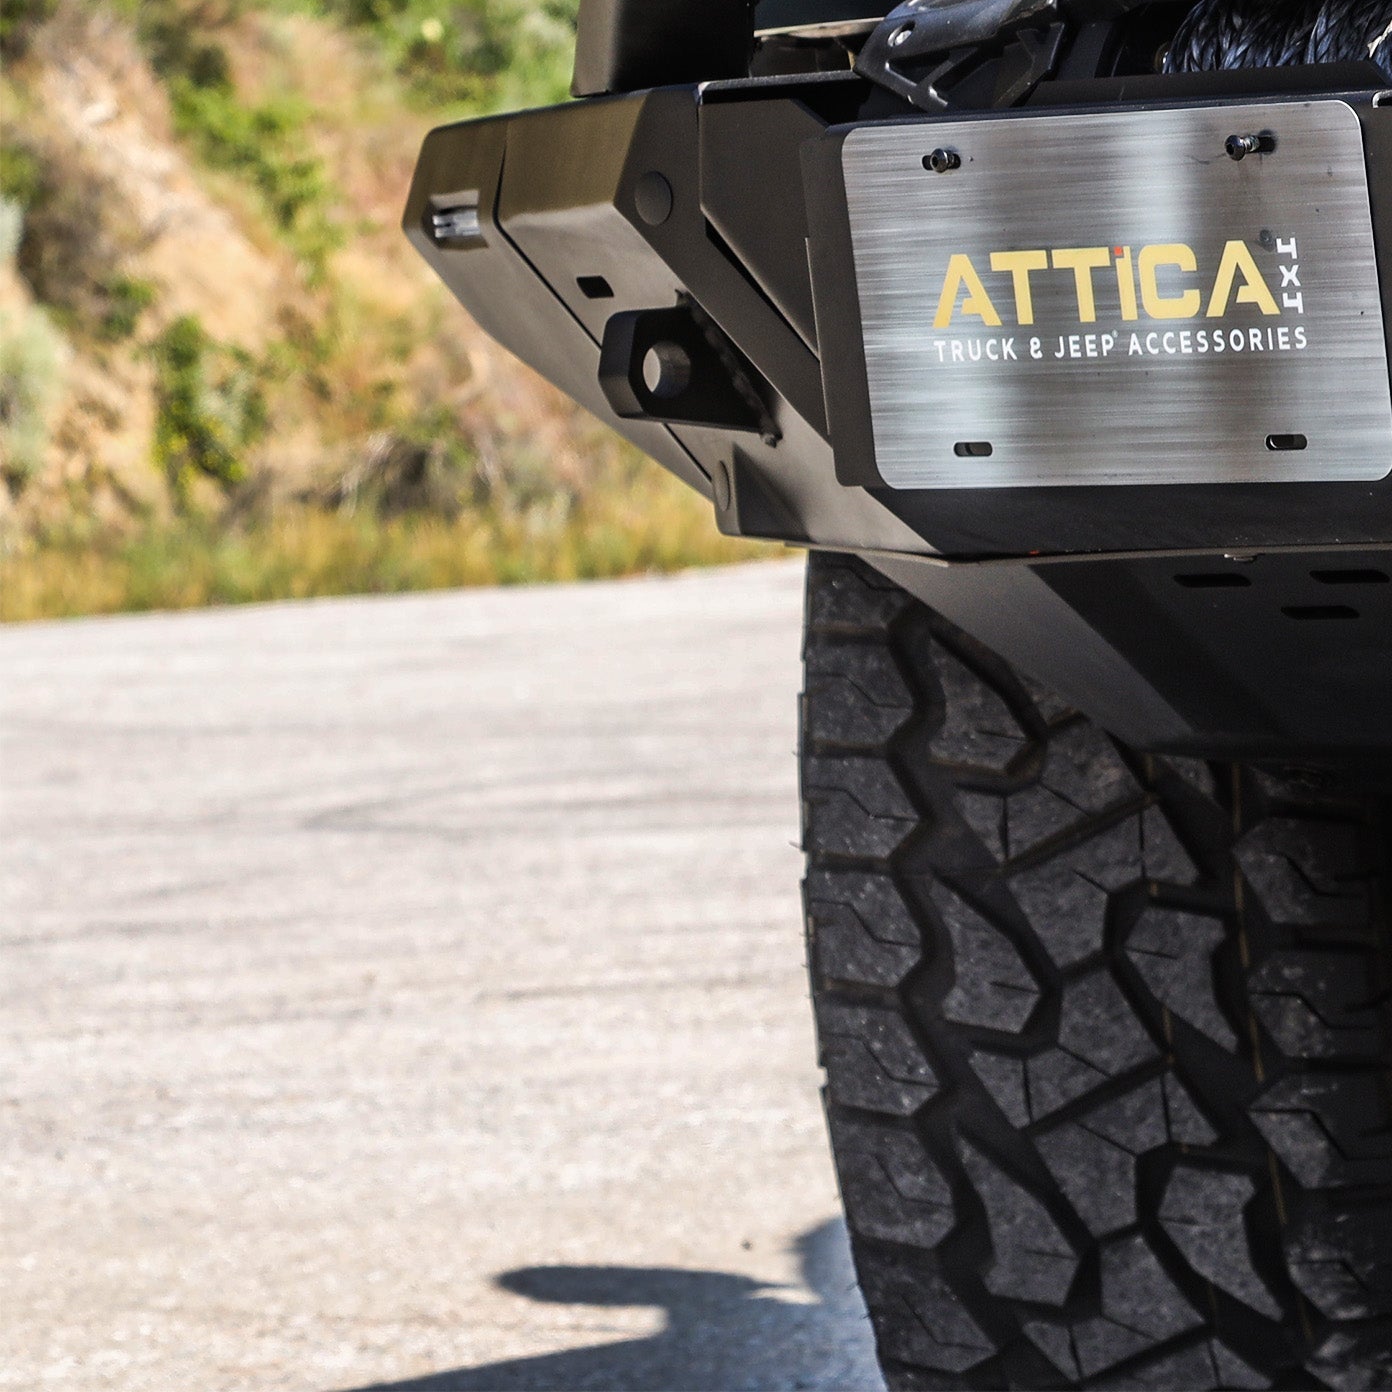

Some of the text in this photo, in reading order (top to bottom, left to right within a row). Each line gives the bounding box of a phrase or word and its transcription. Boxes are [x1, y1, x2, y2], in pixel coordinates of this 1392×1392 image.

[934, 337, 1017, 363] TRUCK
[1030, 337, 1043, 359] &
[1128, 326, 1307, 356] ACCESSORIES
